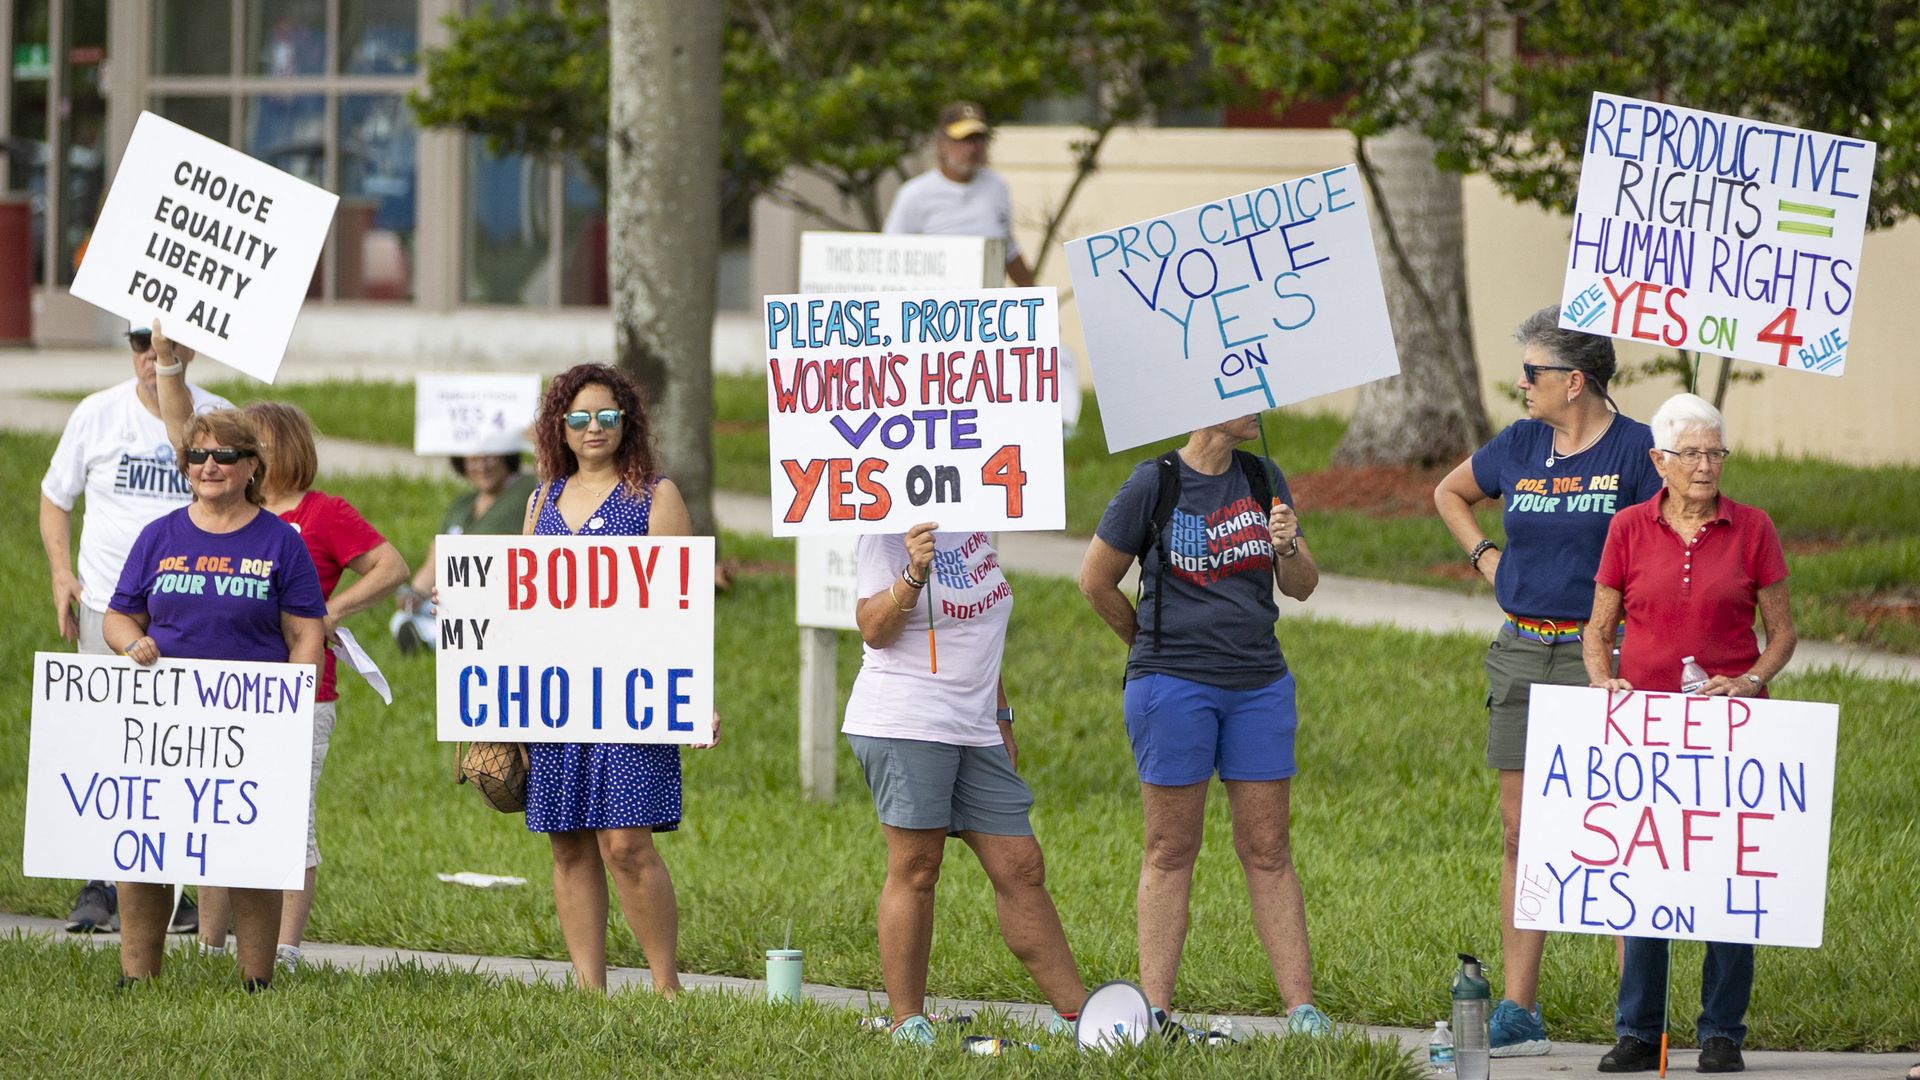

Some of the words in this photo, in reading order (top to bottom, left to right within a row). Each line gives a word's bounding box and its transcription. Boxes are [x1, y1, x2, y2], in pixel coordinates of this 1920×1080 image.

[1590, 98, 1865, 199] REPRODUCTIVE
[174, 161, 273, 223] CHOICE
[1086, 220, 1177, 277] PRO
[1198, 167, 1356, 245] CHOICE
[1615, 159, 1762, 239] RIGHTS
[145, 232, 252, 299] LIBERTY
[154, 196, 278, 270] EQUALITY
[1118, 217, 1330, 311] VOTE
[1572, 213, 1695, 289] HUMAN
[1709, 236, 1853, 316] RIGHTS
[128, 270, 178, 312] FOR
[186, 300, 231, 340] ALL
[767, 300, 892, 349] PLEASE,
[902, 298, 1044, 343] PROTECT
[1159, 271, 1316, 360] YES
[1563, 283, 1604, 324] VOTE
[1603, 276, 1688, 347] YES
[1699, 315, 1738, 351] ON
[1757, 307, 1803, 367] 4
[1798, 327, 1849, 369] BLUE
[769, 352, 909, 414] WOMEN'S
[920, 346, 1059, 405] HEALTH
[1214, 366, 1276, 409] 4
[1220, 342, 1269, 377] ON
[829, 409, 982, 450] VOTE
[780, 457, 892, 523] YES
[906, 464, 961, 506] on
[981, 444, 1027, 518] 4
[1508, 494, 1560, 513] YOUR
[1566, 494, 1617, 514] VOTE
[1588, 474, 1619, 491] ROE
[152, 573, 206, 595] YOUR
[214, 575, 270, 600] VOTE
[196, 556, 234, 575] ROE,
[240, 558, 273, 578] ROE
[447, 555, 494, 587] MY
[507, 545, 690, 610] BODY!
[441, 618, 490, 650] MY
[46, 659, 186, 707] PROTECT
[459, 665, 694, 732] CHOICE
[123, 717, 245, 768] RIGHTS
[1604, 691, 1751, 751] KEEP
[60, 772, 161, 820] VOTE
[184, 778, 258, 825] YES
[1543, 744, 1806, 812] ABORTION
[113, 830, 166, 873] ON
[186, 832, 207, 876] 4
[1571, 802, 1778, 878] SAFE
[1516, 864, 1553, 922] VOTE
[1545, 862, 1636, 930] YES
[1651, 905, 1695, 933] ON
[1727, 878, 1768, 939] 4
